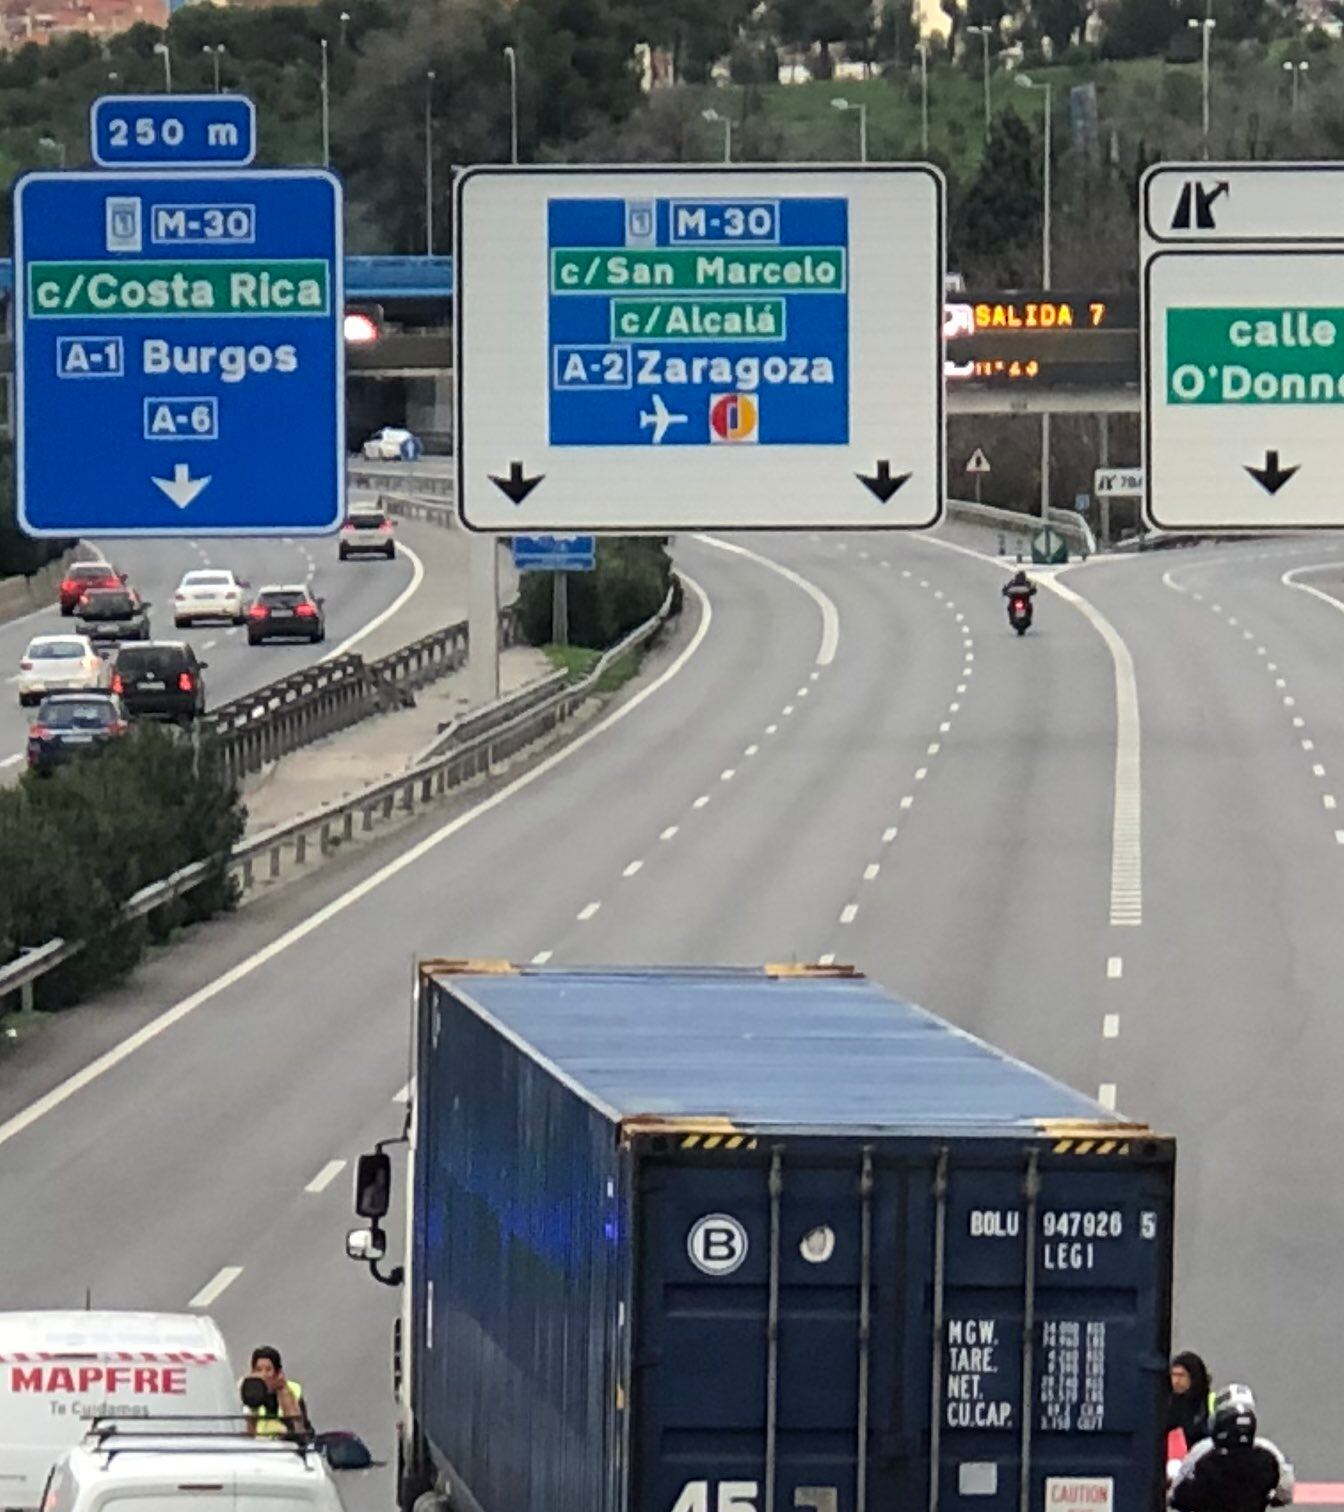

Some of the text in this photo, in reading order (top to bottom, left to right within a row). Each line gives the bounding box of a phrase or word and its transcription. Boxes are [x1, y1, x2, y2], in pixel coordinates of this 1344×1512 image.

[109, 118, 239, 146] 250 m
[157, 210, 250, 238] M-30
[677, 207, 772, 237] M-30
[560, 255, 837, 286] c/San Marcelo
[36, 271, 322, 309] c/Costa Rica
[620, 304, 776, 334] c/Alcalá
[975, 302, 1106, 328] SALIDA 7
[1228, 311, 1337, 347] calle
[64, 338, 298, 382] A-1 Burgos
[562, 349, 835, 391] A-2 Zaragoza
[150, 405, 212, 433] A-6
[970, 1211, 1020, 1237] BOLU
[1140, 1212, 1156, 1239] 5
[702, 1228, 735, 1261] B
[948, 1320, 999, 1346] MGW.
[948, 1347, 999, 1374] TARE.
[10, 1366, 188, 1395] MAPFRE
[947, 1374, 984, 1401] NET.
[1051, 1484, 1109, 1503] CAUTION
